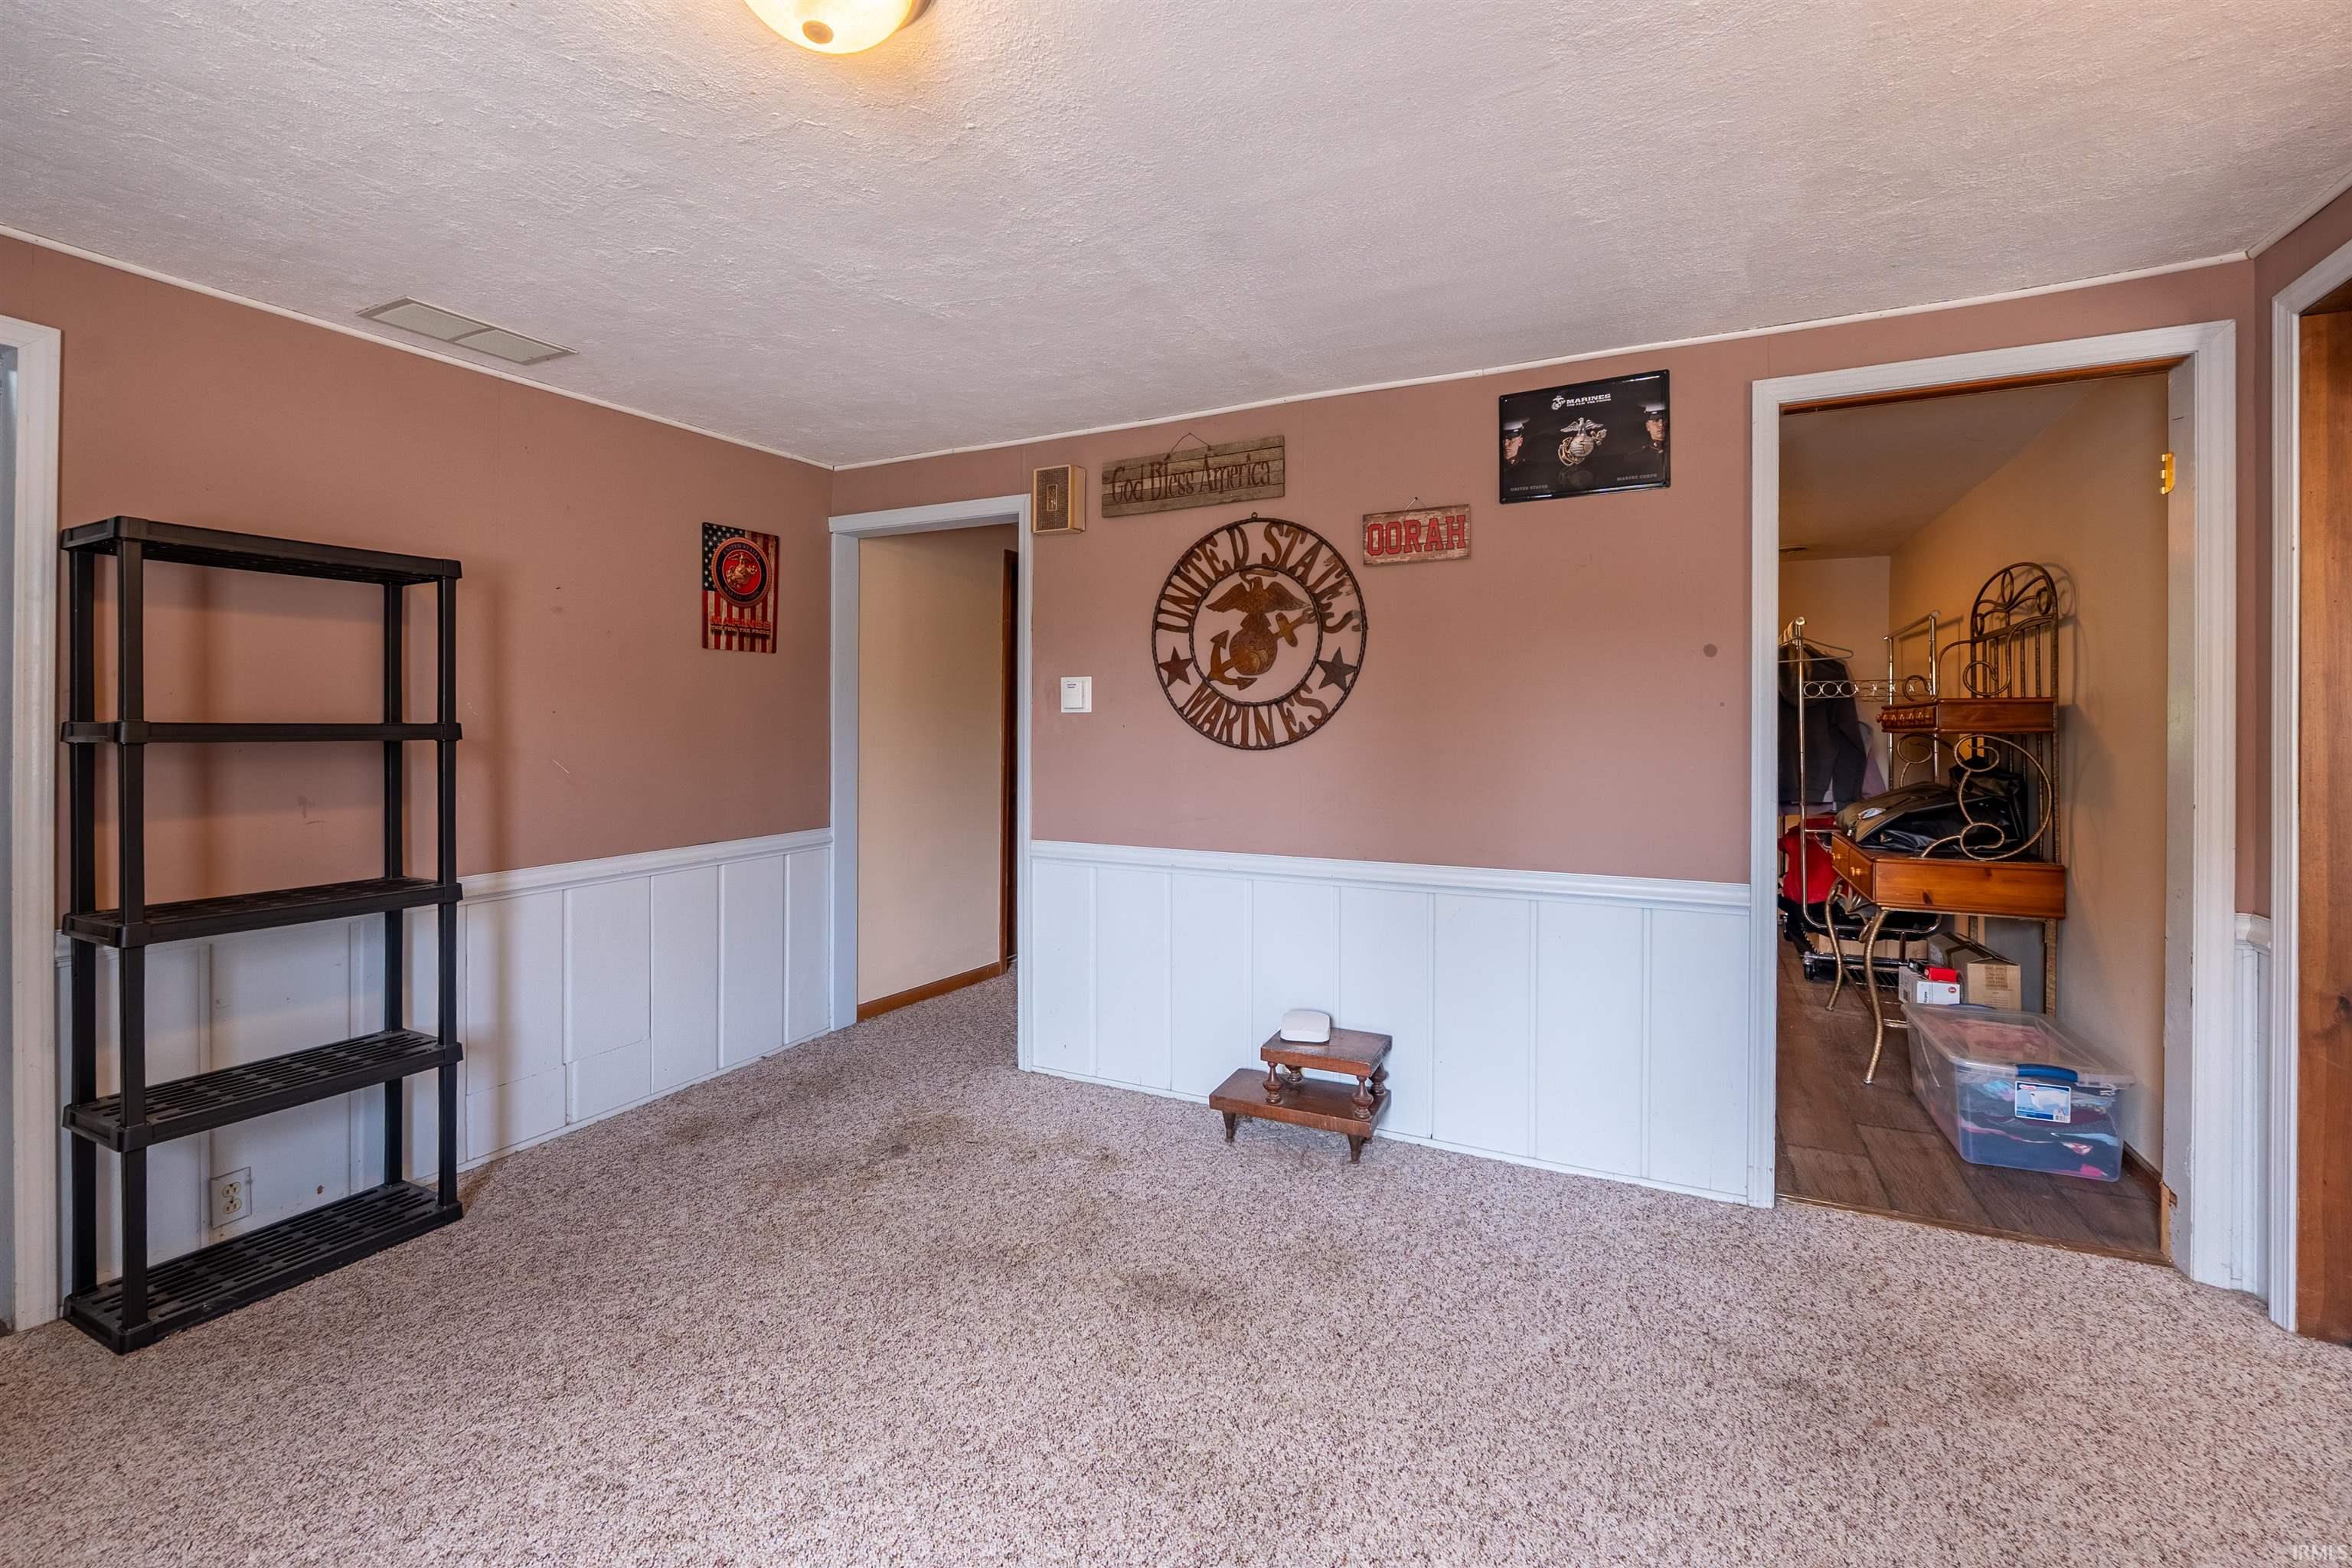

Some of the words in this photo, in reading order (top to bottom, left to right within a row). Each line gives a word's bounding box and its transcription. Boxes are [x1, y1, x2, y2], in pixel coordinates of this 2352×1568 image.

[1566, 394, 1612, 404] MARINES
[1112, 465, 1144, 504] God
[1150, 460, 1194, 500] Bless
[1199, 453, 1270, 494] America
[1367, 514, 1466, 556] OORAH
[1156, 525, 1250, 634] UNITED
[1261, 522, 1361, 634] STATES
[710, 616, 772, 629] MARINES
[1179, 681, 1329, 748] MARINES
